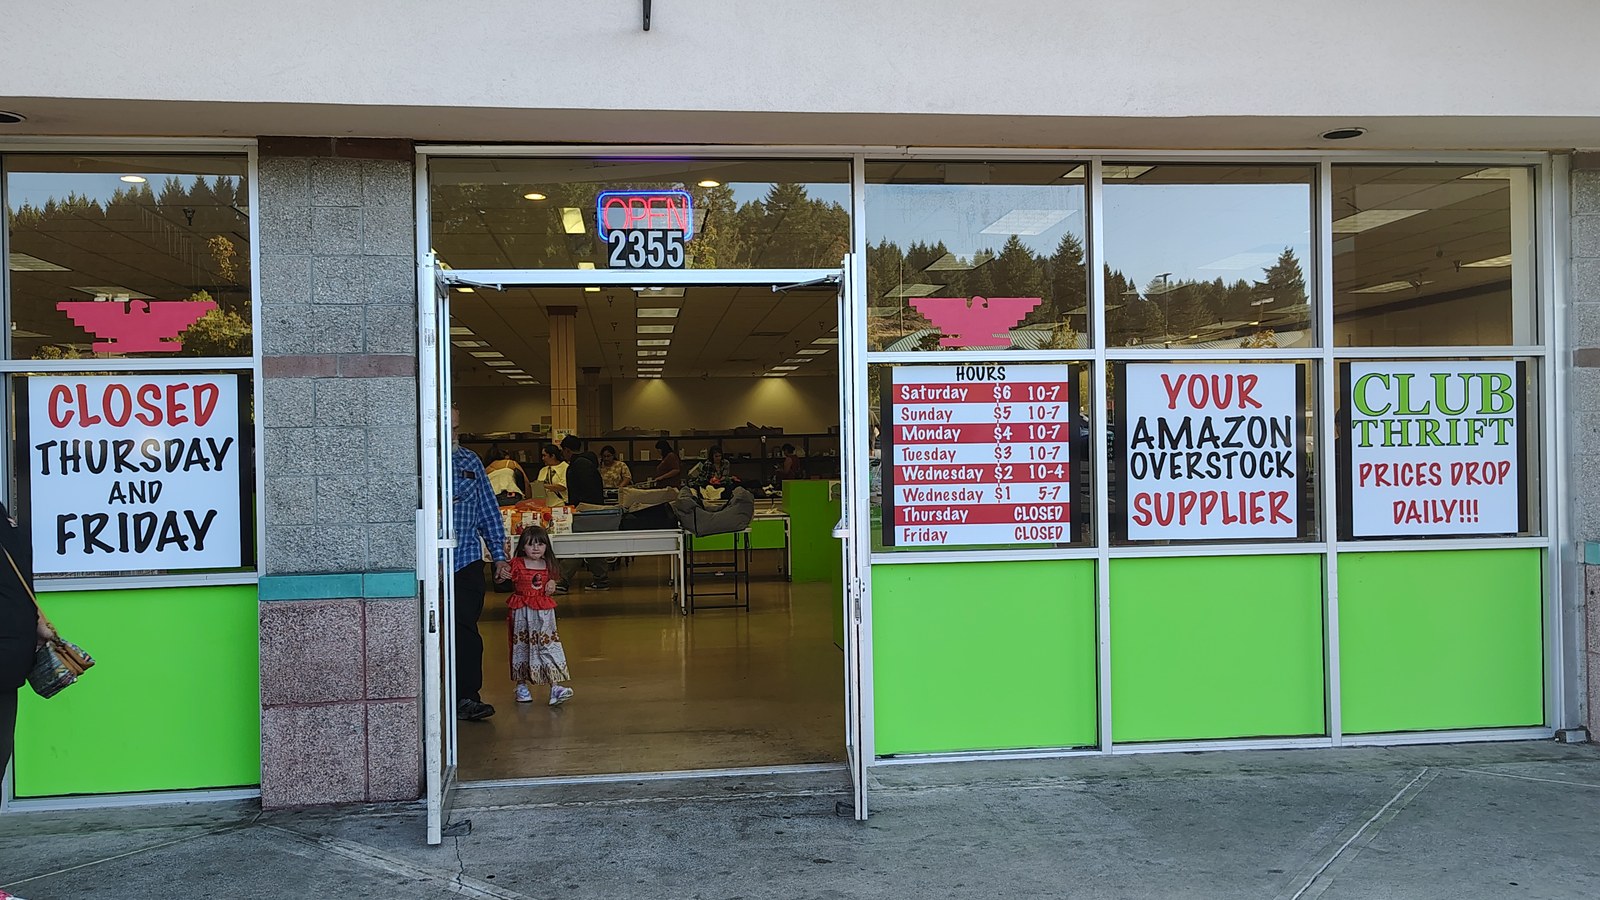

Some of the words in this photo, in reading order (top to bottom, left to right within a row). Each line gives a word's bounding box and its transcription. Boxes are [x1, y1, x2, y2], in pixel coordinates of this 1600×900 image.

[603, 197, 687, 231] OPEN
[609, 230, 684, 268] 2355
[956, 366, 1006, 381] HOURS
[901, 385, 968, 401] Saturday
[993, 384, 1012, 402] $6
[1028, 385, 1060, 400] 10-7
[1161, 374, 1262, 409] YOUR
[1353, 372, 1514, 416] CLUB
[48, 383, 219, 428] CLOSED
[901, 407, 953, 422] Sunday
[994, 404, 1012, 422] $5
[1029, 405, 1060, 420] 10-7
[902, 426, 961, 442] Monday
[994, 425, 1013, 443] $4
[1029, 425, 1061, 440] 10-7
[1131, 415, 1292, 450] AMAZON
[1352, 418, 1514, 447] THRIFT
[35, 437, 234, 475] THURSDAY
[902, 447, 956, 463] Tuesday
[994, 445, 1012, 463] $3
[1030, 446, 1061, 460] 10-7
[1131, 451, 1294, 480] OVERSTOCK
[902, 466, 983, 482] Wednesday
[994, 464, 1013, 482] $2
[1029, 465, 1064, 479] 10-4
[1359, 462, 1442, 487] PRICES
[1450, 461, 1511, 486] DROP
[108, 480, 162, 505] AND
[903, 488, 984, 503] Wednesday
[995, 485, 1011, 501] $1
[1038, 486, 1061, 500] 5-7
[902, 507, 968, 523] Thursday
[1014, 505, 1063, 521] CLOSED
[1132, 491, 1293, 526] SUPPLIER
[1393, 499, 1479, 525] DAILY!!!
[57, 510, 217, 555] FRIDAY
[903, 528, 948, 544] Friday
[1014, 526, 1063, 540] CLOSED
